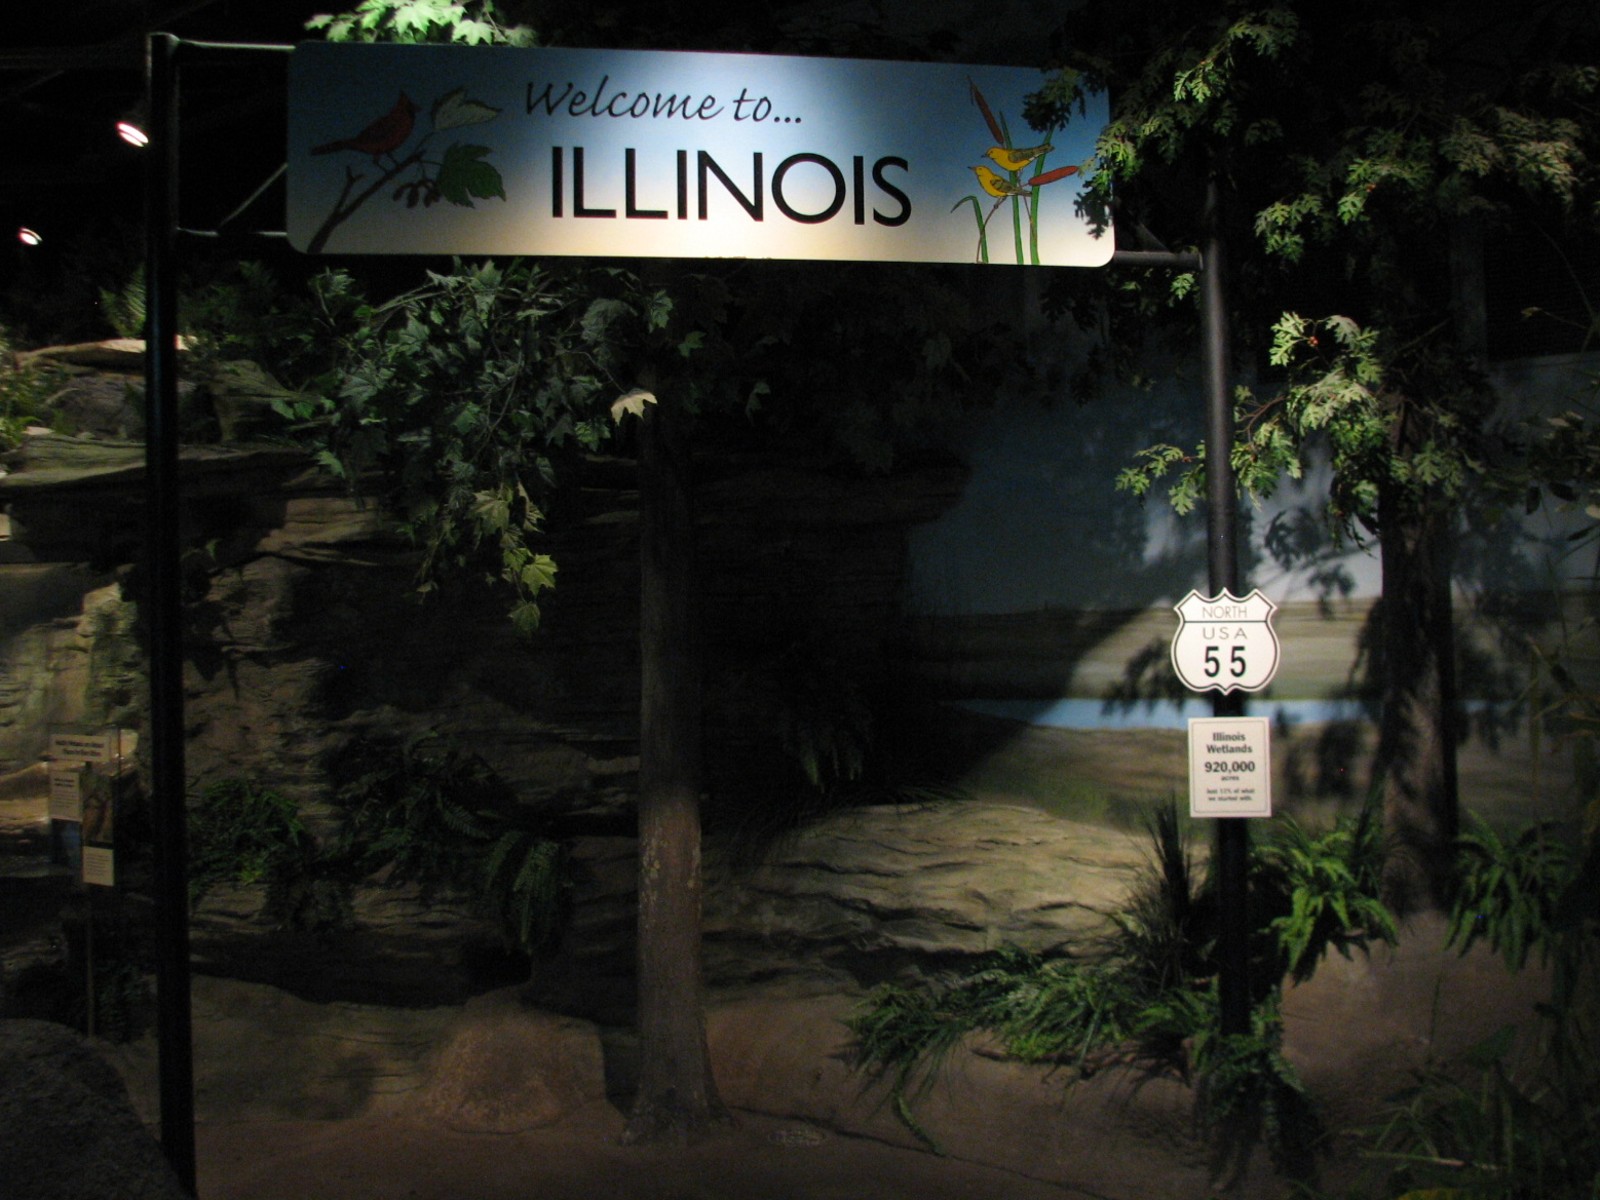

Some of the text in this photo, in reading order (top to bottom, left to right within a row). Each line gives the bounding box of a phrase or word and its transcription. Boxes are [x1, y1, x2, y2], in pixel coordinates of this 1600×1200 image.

[526, 75, 803, 124] Welcome to...
[551, 146, 912, 227] ILLINOIS
[1202, 606, 1247, 618] NORTH
[1202, 626, 1248, 640] USA
[1204, 646, 1246, 678] 55
[1213, 732, 1246, 741] Illinois
[1206, 744, 1253, 754] Wetlands
[1204, 761, 1255, 774] 920,000
